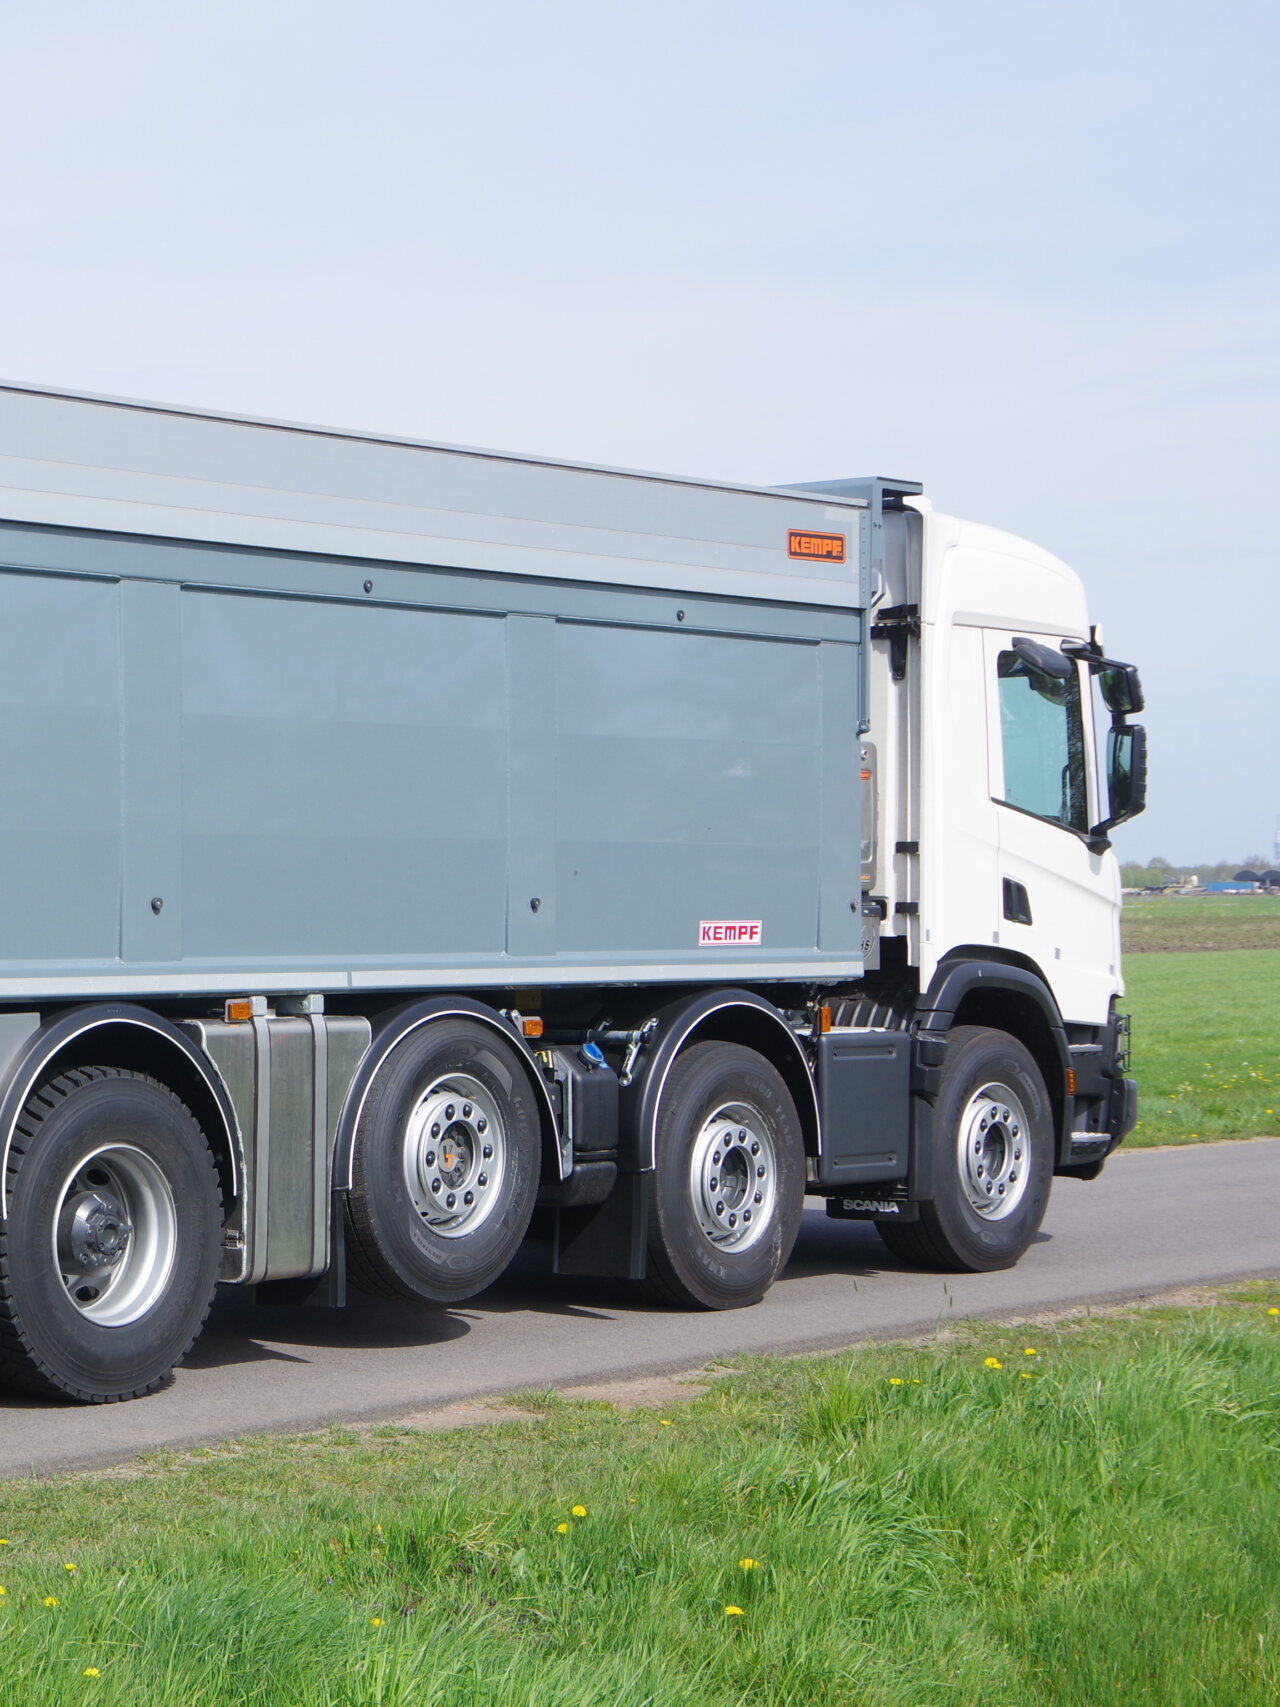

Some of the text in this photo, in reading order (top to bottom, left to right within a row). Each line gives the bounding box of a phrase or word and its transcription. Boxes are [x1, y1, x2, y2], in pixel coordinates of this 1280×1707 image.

[790, 535, 843, 556] KEMPF
[702, 925, 759, 941] KEMPF
[842, 1199, 900, 1214] SCANIA
